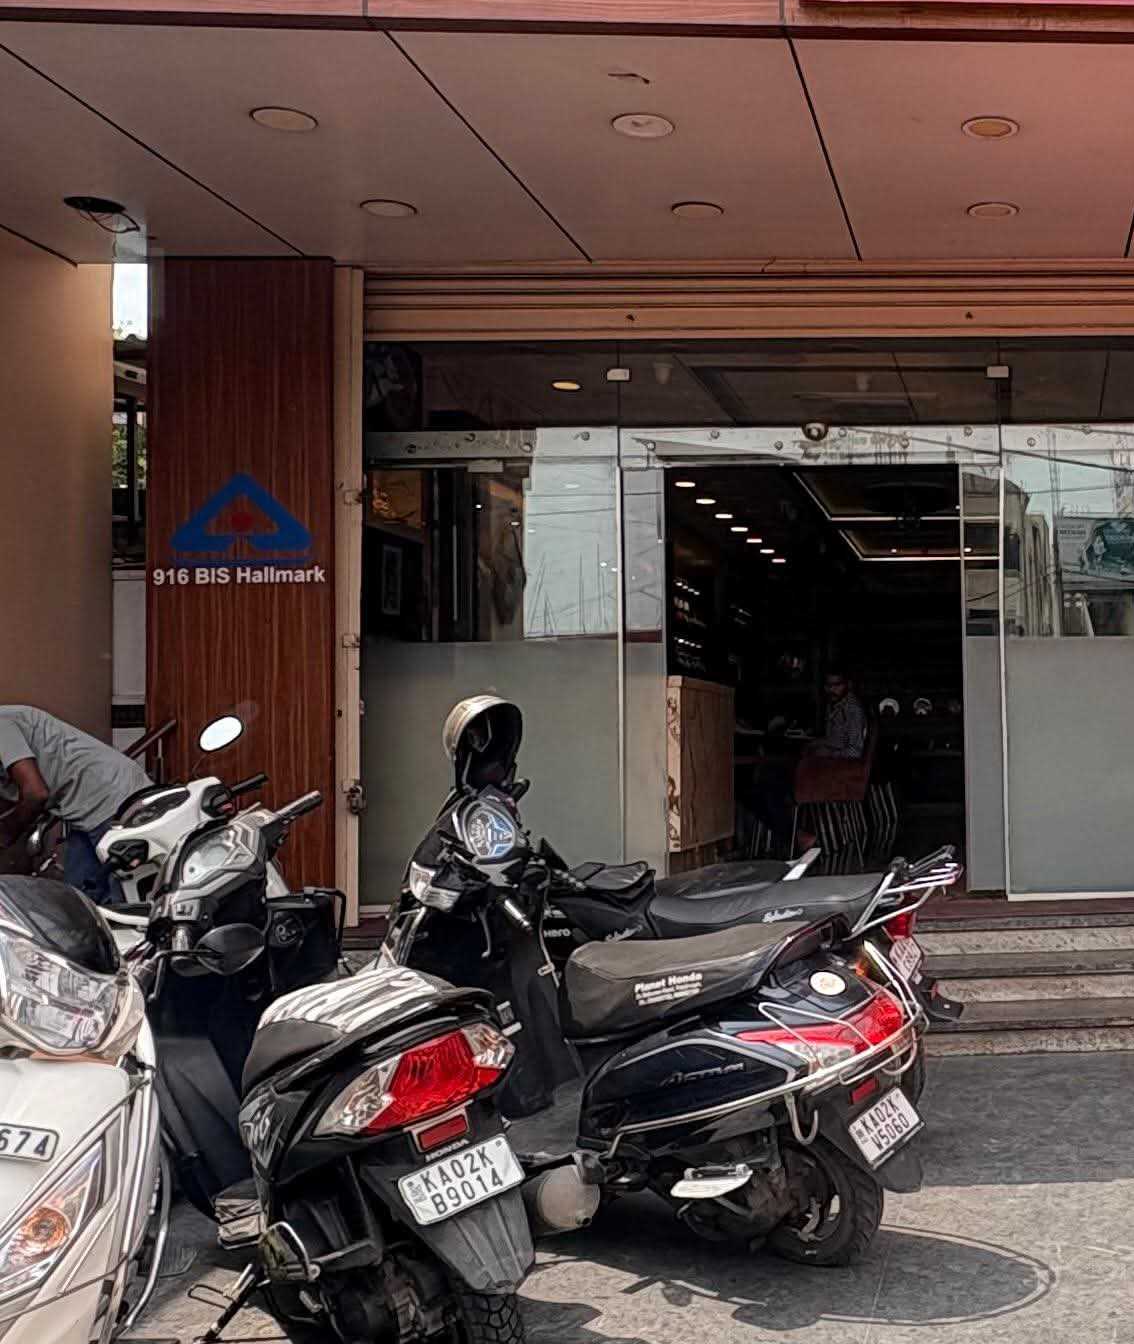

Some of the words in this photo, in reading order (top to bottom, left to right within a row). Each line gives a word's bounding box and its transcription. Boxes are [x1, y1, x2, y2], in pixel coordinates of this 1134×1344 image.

[153, 568, 189, 585] 916
[195, 567, 230, 584] BIS
[236, 566, 325, 584] Hallmark
[860, 1096, 900, 1135] KA02K
[421, 1147, 493, 1192] KA02K
[430, 1168, 503, 1214] B9014
